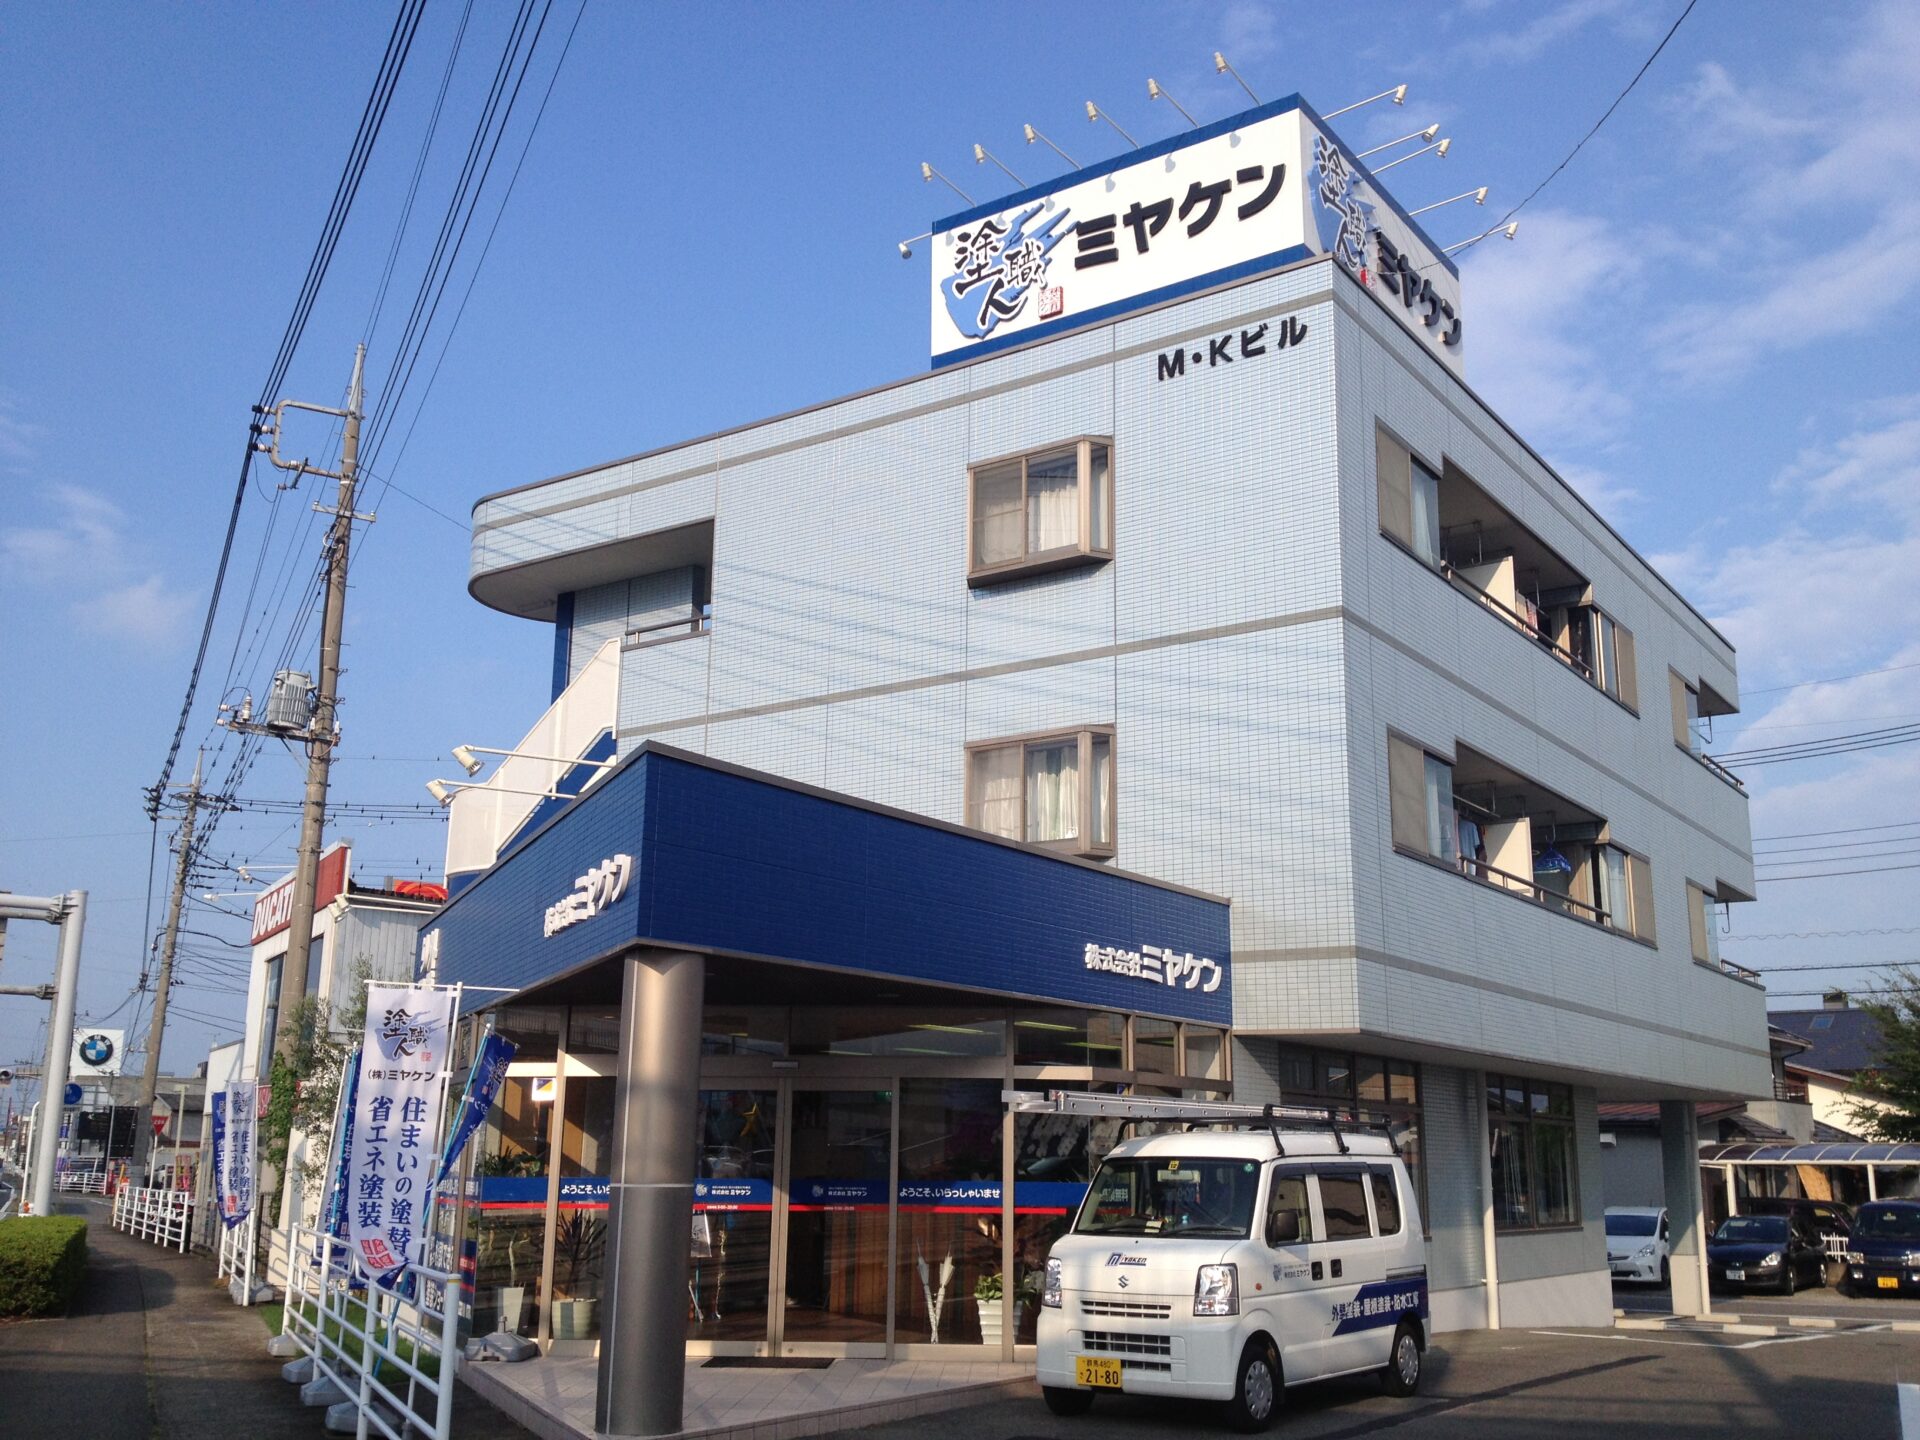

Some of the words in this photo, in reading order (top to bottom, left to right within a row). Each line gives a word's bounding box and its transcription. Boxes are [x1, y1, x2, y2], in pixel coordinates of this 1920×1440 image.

[1074, 163, 1286, 270] ミヤケン
[1376, 231, 1462, 346] ミヤケン
[1158, 315, 1308, 382] M・Kビル
[252, 880, 296, 938] DUCATI
[1084, 943, 1222, 993] 株式会社ミヤケン
[357, 1096, 395, 1228] 省エネ塗装
[900, 1187, 1001, 1198] ようこそ、いらっしゃいませ
[1086, 1368, 1119, 1385] 21-80
